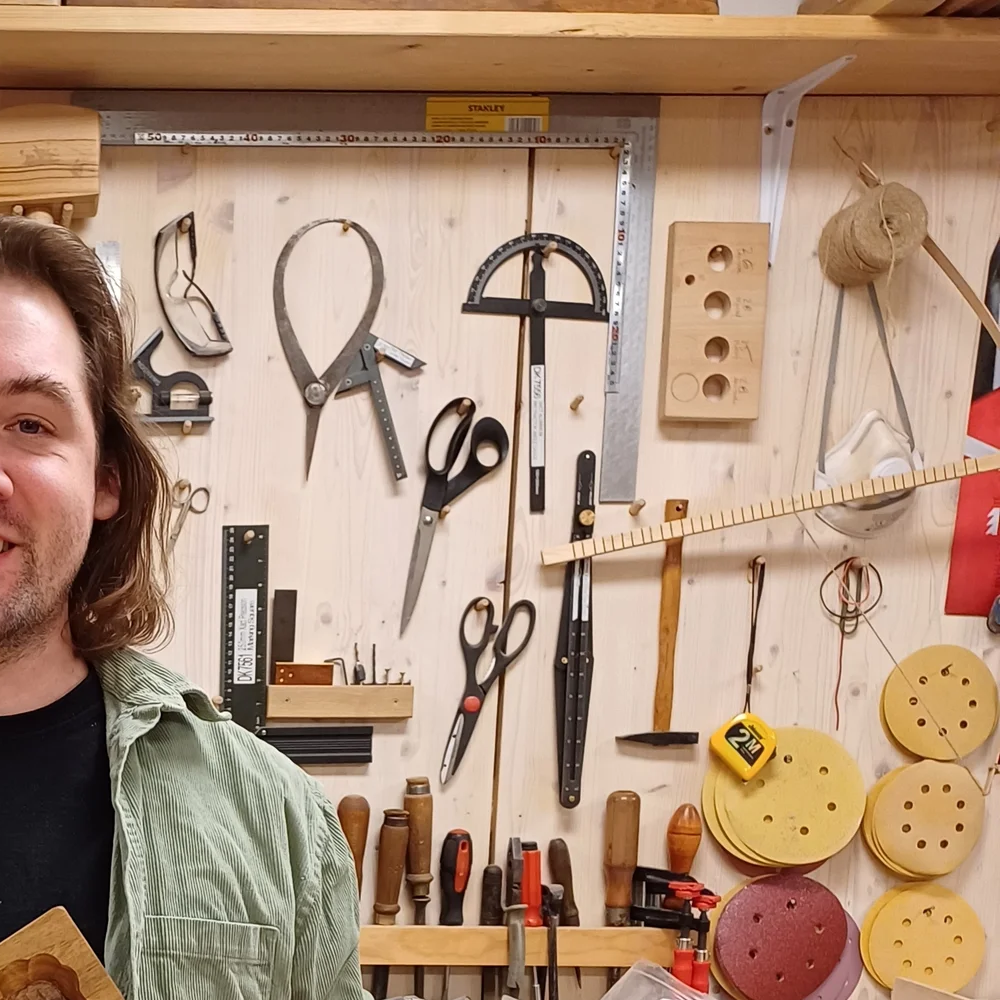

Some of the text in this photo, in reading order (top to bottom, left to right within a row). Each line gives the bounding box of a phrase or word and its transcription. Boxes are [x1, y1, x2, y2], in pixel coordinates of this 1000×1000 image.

[468, 104, 505, 112] STANLEY
[147, 133, 162, 141] 50
[243, 134, 258, 142] 40
[340, 134, 355, 142] 30
[436, 134, 450, 142] 20
[535, 135, 546, 143] 10
[618, 228, 625, 241] 10
[612, 326, 619, 341] 20
[237, 654, 253, 682] DK7561
[728, 728, 762, 754] 2M
